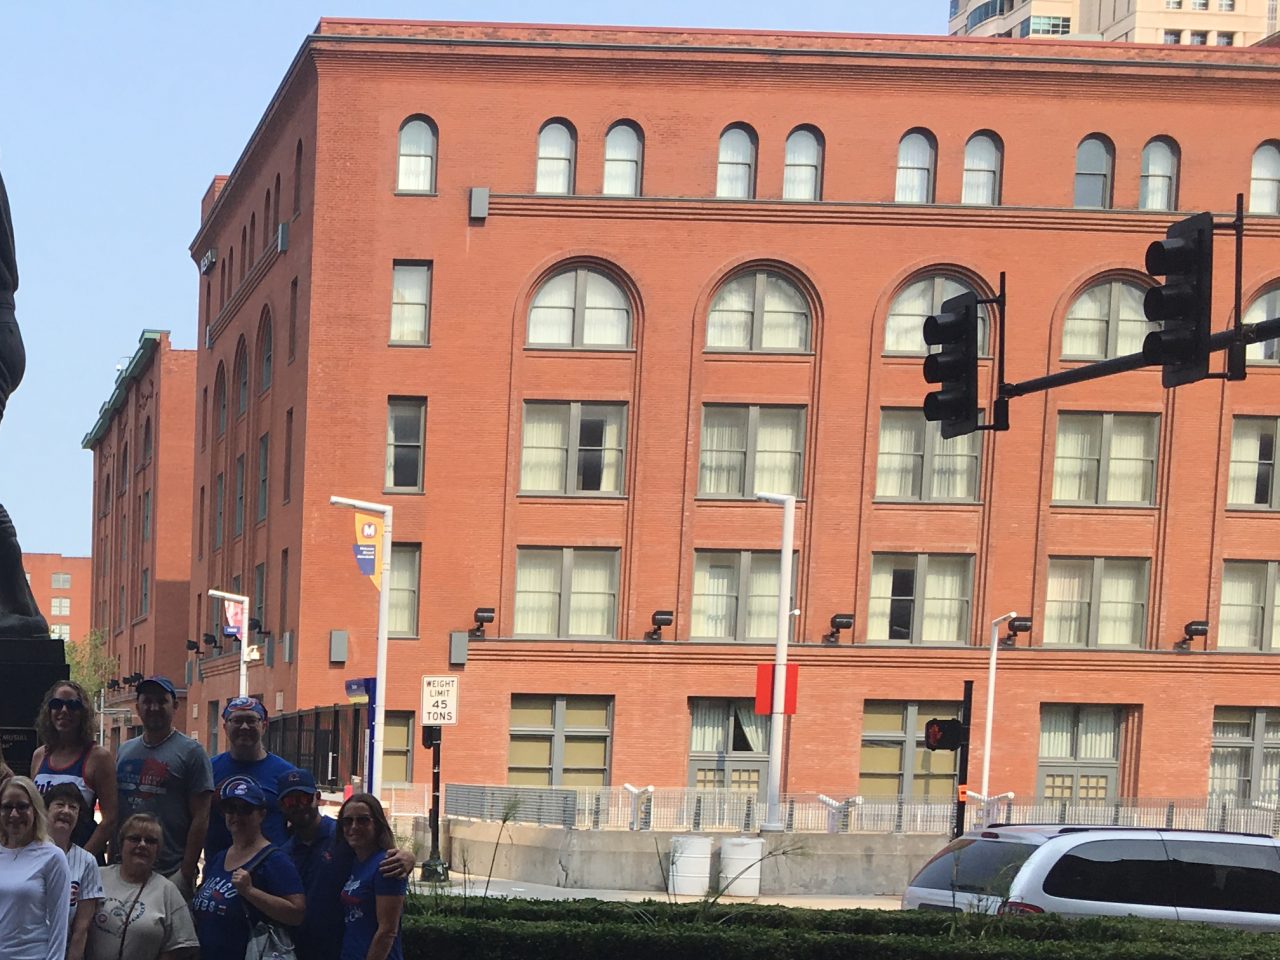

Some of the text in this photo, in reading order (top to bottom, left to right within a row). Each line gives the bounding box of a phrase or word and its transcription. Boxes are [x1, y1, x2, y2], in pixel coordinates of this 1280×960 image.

[426, 680, 455, 688] WEIGHT
[429, 690, 450, 698] LIMIT
[432, 701, 448, 709] 45
[427, 711, 453, 721] TONS
